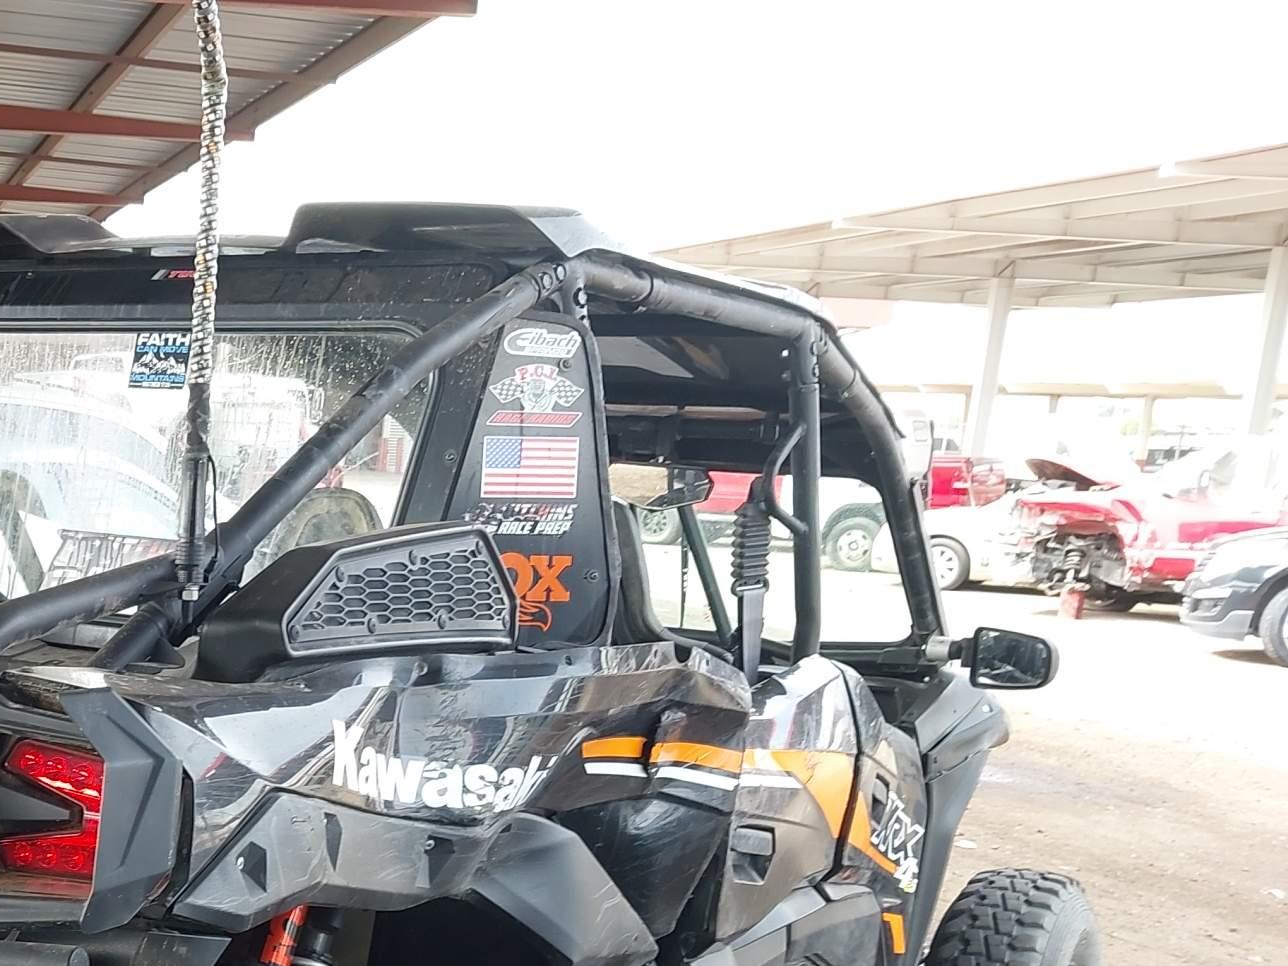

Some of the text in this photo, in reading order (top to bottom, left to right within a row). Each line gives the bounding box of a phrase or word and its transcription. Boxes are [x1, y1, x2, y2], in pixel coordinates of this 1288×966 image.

[137, 333, 191, 346] FAITH
[516, 330, 578, 348] Eibach
[159, 346, 189, 354] MOVE
[130, 374, 185, 382] MOUNTAINS
[497, 521, 573, 535] RACE PREP
[499, 552, 573, 602] OX
